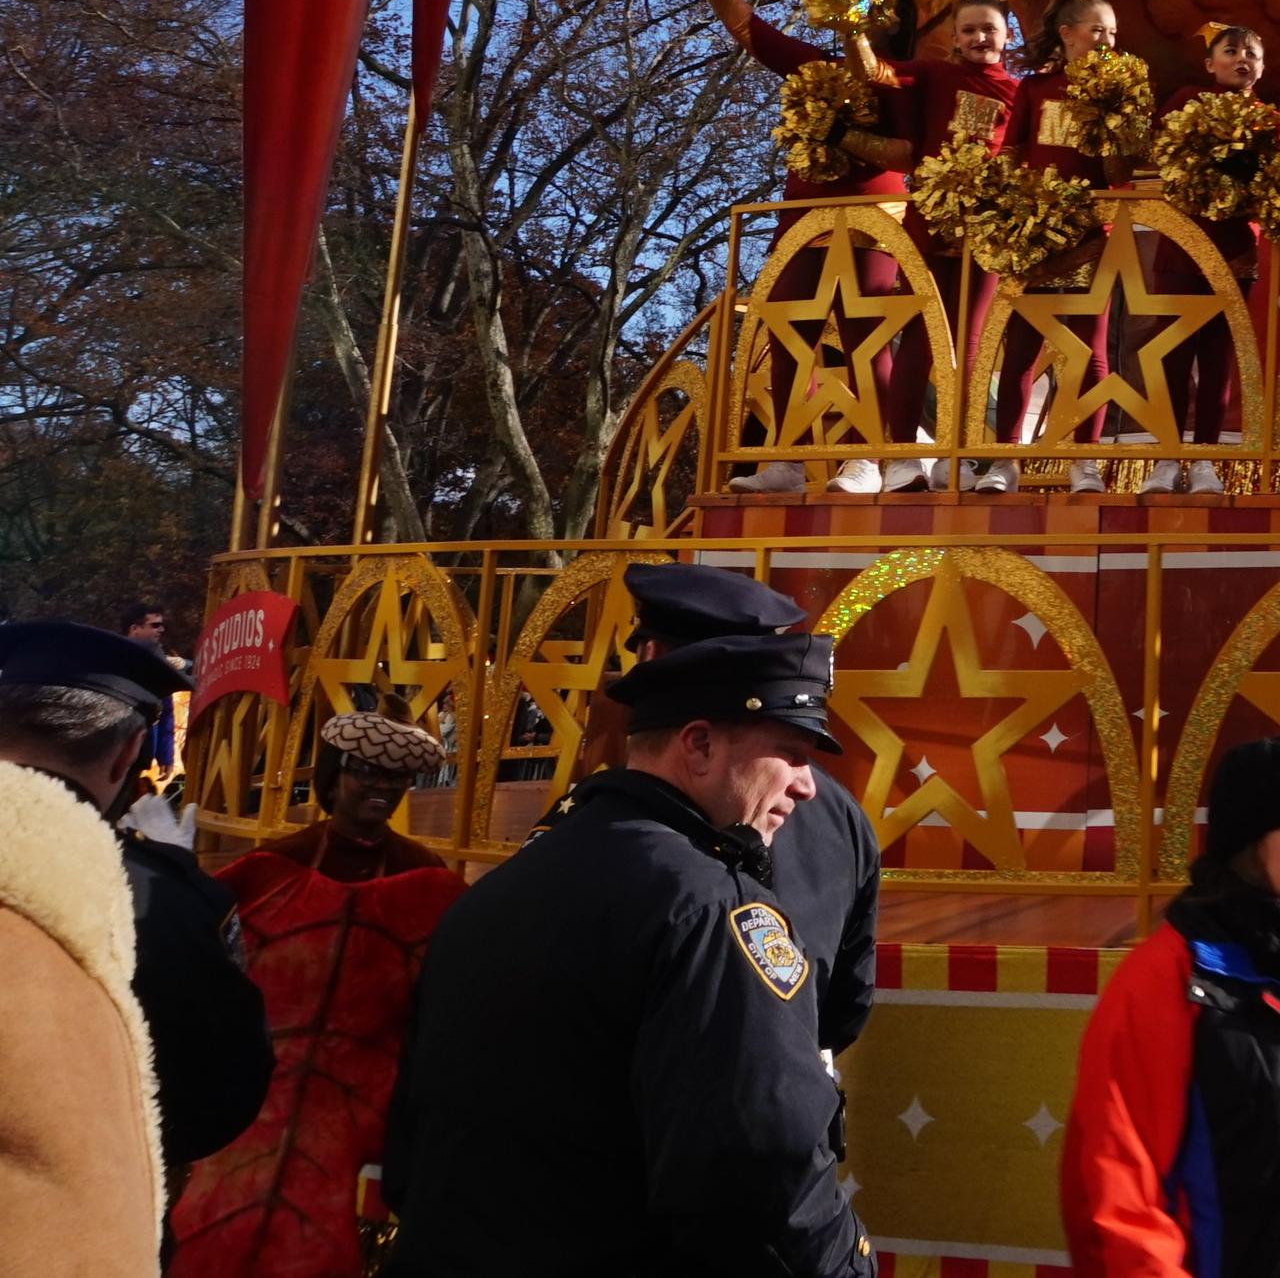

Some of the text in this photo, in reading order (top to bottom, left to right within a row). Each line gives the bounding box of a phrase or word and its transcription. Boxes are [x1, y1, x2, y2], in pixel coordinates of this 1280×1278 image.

[210, 609, 265, 664] STUDIOS
[748, 943, 778, 980] CITY OF
